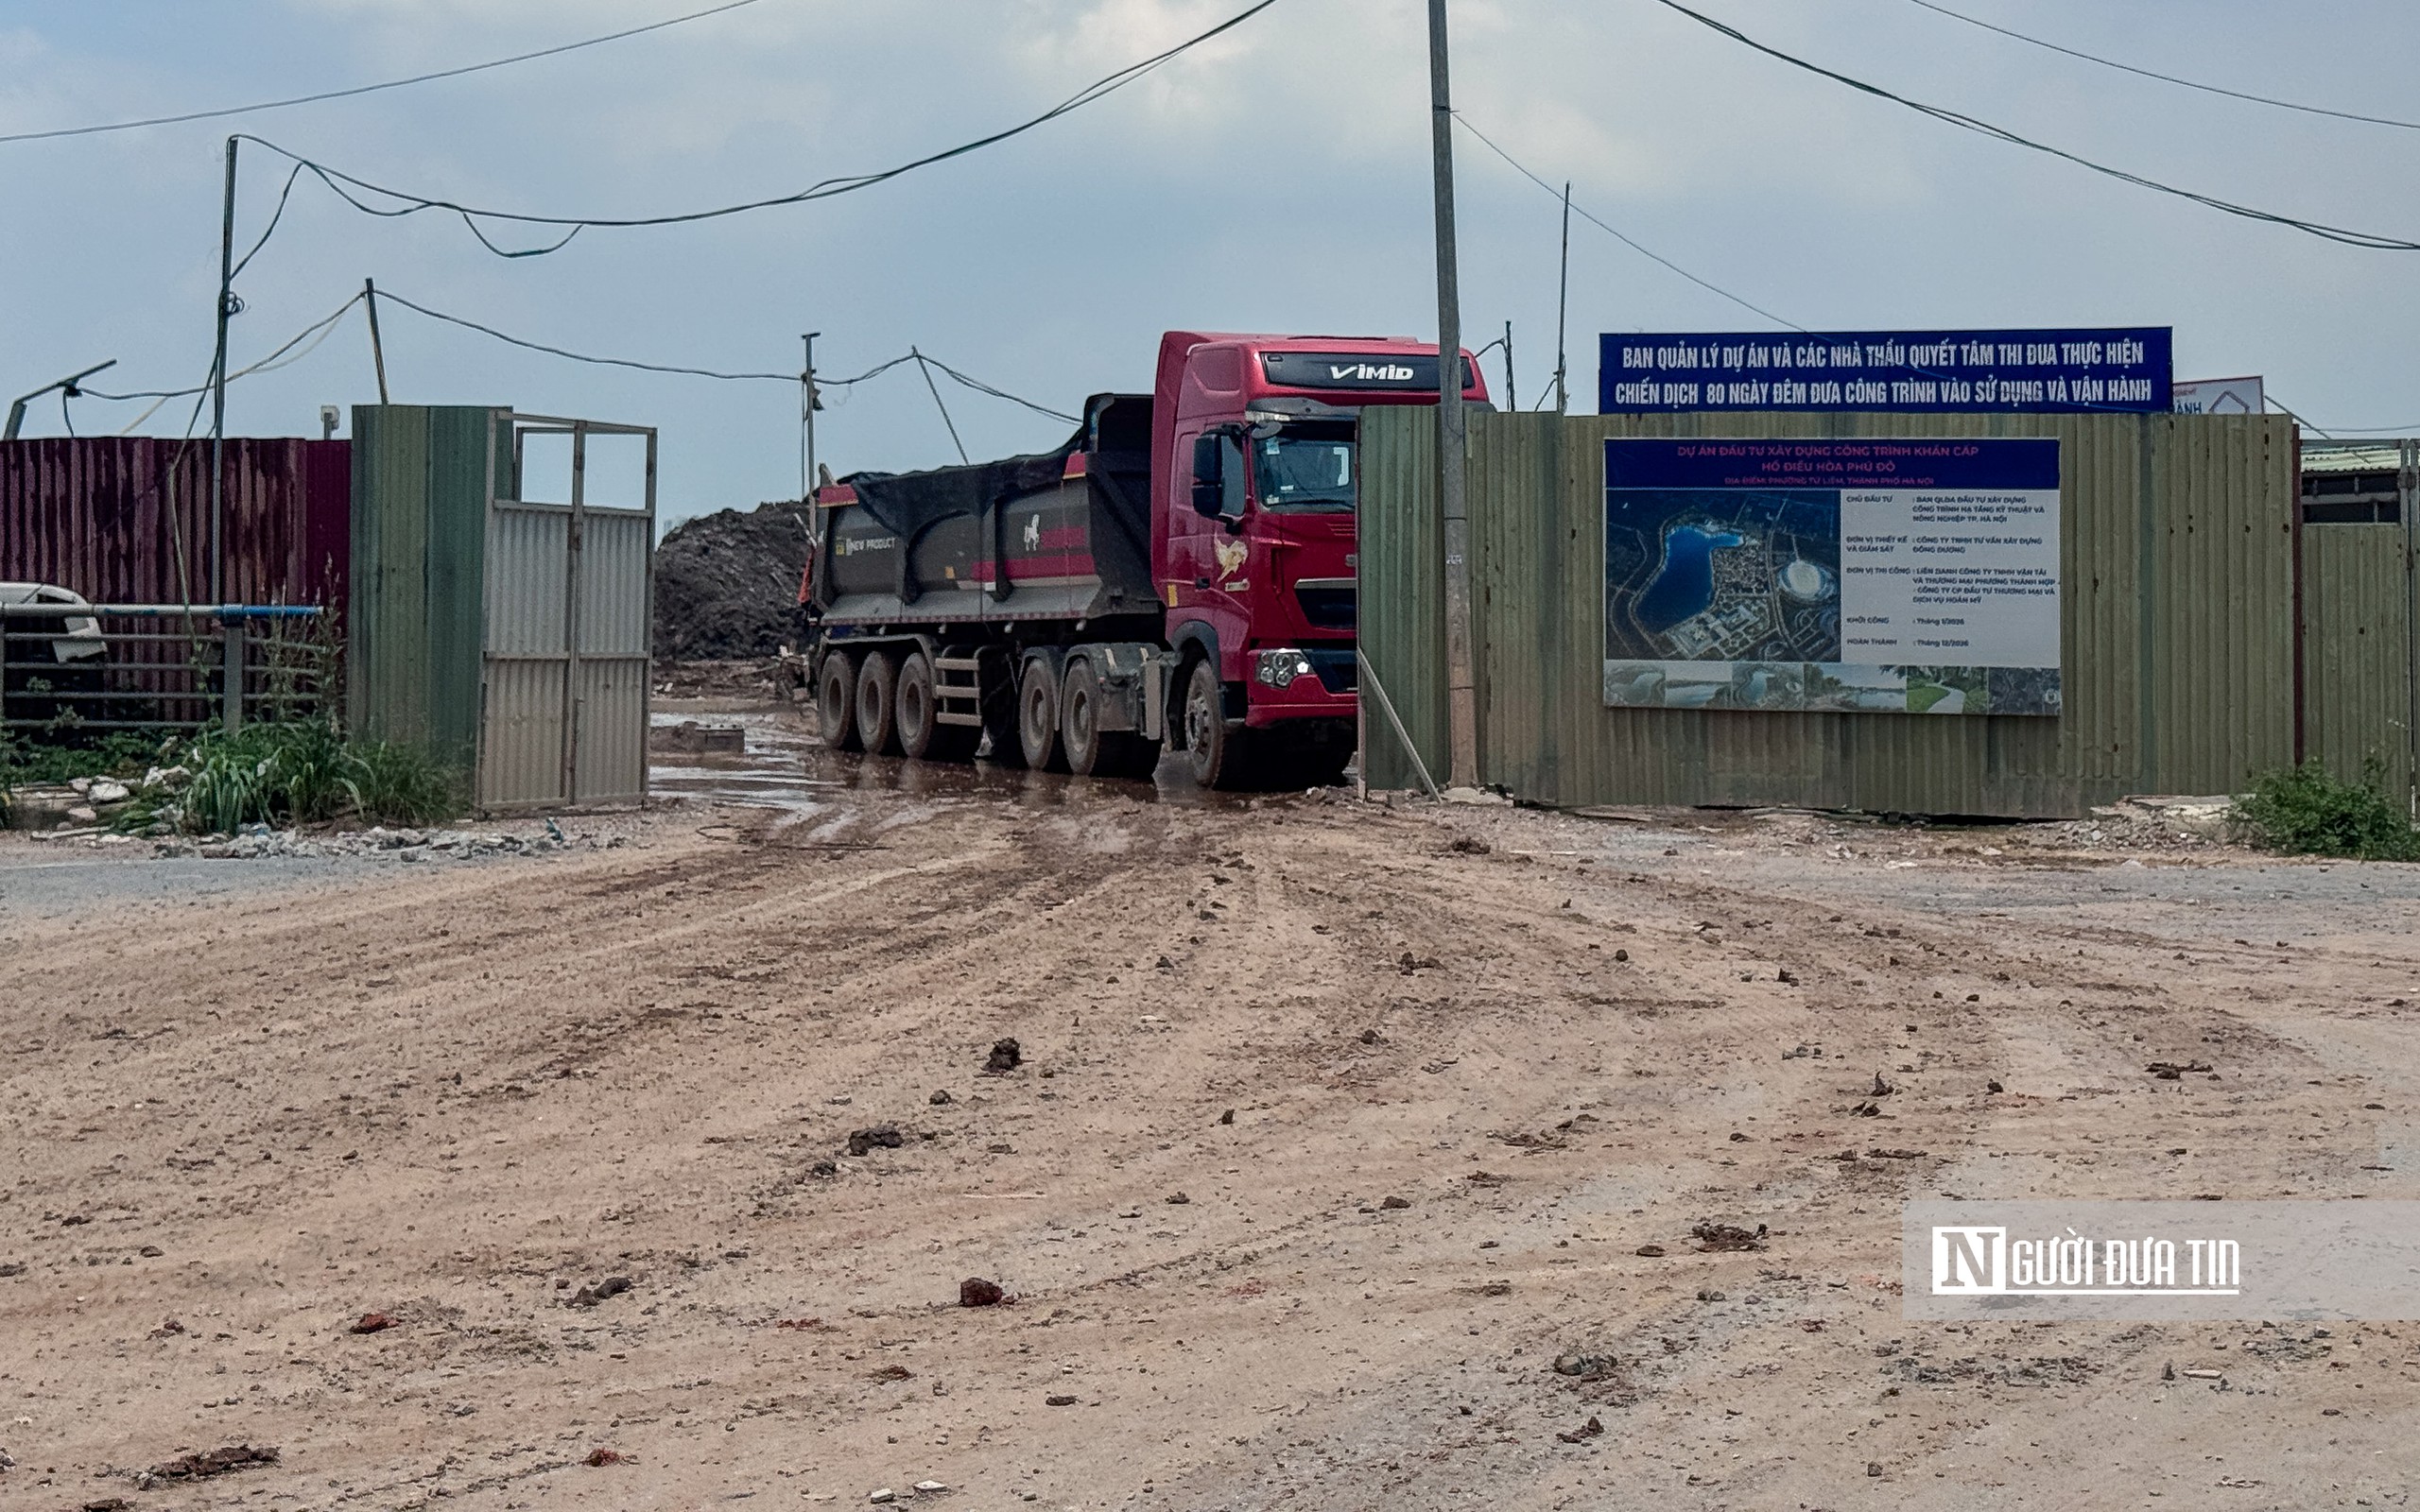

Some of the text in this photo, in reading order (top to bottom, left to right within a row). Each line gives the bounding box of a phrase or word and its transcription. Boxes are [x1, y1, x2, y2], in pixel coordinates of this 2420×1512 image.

[1623, 346, 1653, 368] BAN
[1657, 340, 1698, 370] QUẢN
[1703, 342, 1719, 368] LÝ
[1722, 345, 1745, 372] DỰ
[1747, 342, 1769, 368] ÁN
[1772, 341, 1792, 368] VÀ
[1796, 342, 1826, 368] CÁC
[1830, 342, 1862, 368] NHÀ
[1910, 337, 1957, 369] QUYẾT
[1961, 340, 1995, 367] TÂM
[1998, 343, 2023, 366] THI
[2027, 343, 2058, 366] ĐUA
[2062, 341, 2102, 369] THỰC
[2106, 337, 2144, 369] HIỆN
[1616, 376, 1660, 404] CHIẾN
[1664, 383, 1699, 409] DỊCH
[1706, 383, 1726, 404] 80
[1729, 378, 1770, 404] NGÀY
[1772, 378, 1806, 404] ĐÊM
[1810, 381, 1841, 404] ĐƯA
[1845, 377, 1888, 404] CÔNG
[1892, 378, 1937, 404] TRÌNH
[1941, 377, 1971, 403] VÀO
[1975, 373, 1997, 403] SỬ
[2000, 380, 2044, 407] DỤNG
[2047, 375, 2068, 402] VÀ
[2071, 375, 2104, 406] VẬN
[2108, 374, 2152, 402] HÀNH
[1677, 445, 1696, 457] DỰ
[1698, 444, 1717, 456] ÁN
[1749, 444, 1765, 456] TƯ
[1768, 444, 1792, 456] XÂY
[1795, 445, 1831, 458] DỤNG
[1834, 443, 1870, 456] CÔNG
[1873, 443, 1911, 456] TRÌNH
